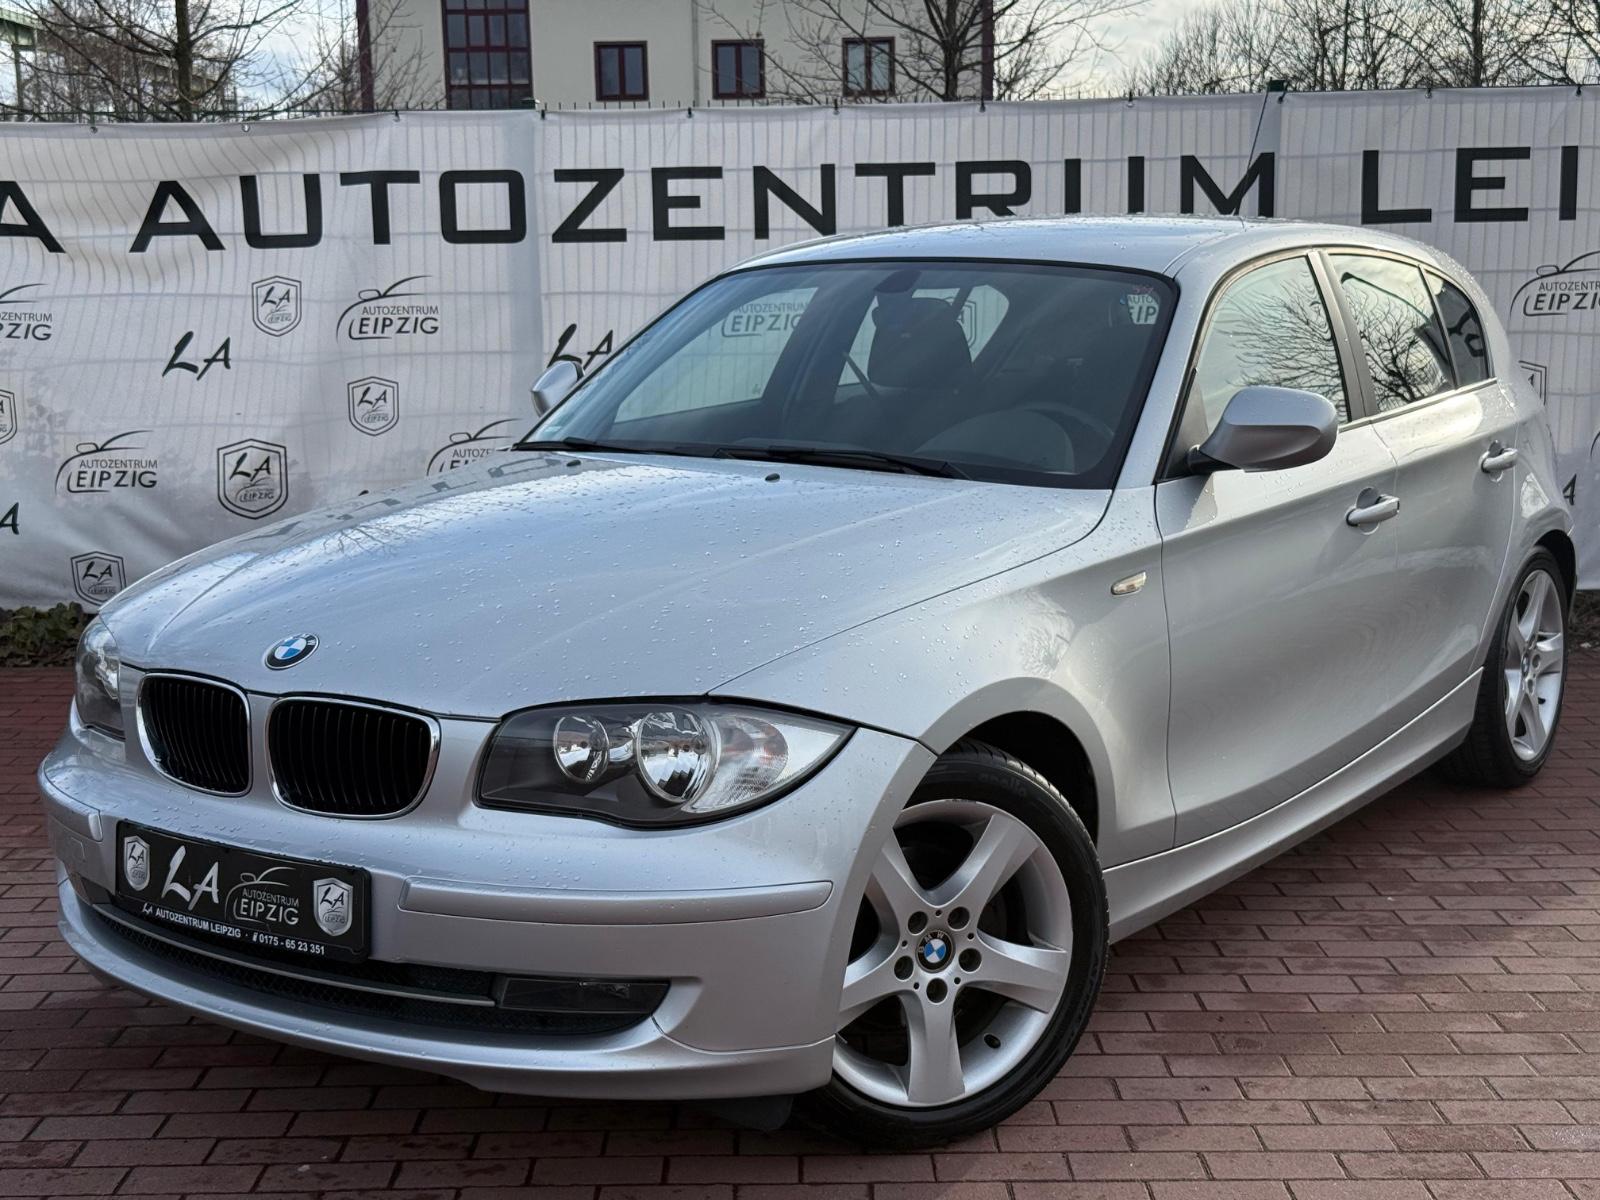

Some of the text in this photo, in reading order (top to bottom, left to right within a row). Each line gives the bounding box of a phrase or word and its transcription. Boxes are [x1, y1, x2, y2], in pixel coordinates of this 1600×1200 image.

[1361, 145, 1579, 224] LEI
[261, 286, 291, 308] LA
[1523, 292, 1600, 317] LEIPZI
[0, 312, 53, 322] ZENTRUM
[362, 305, 439, 315] AUTOZENTRUM
[162, 331, 231, 381] LA
[547, 323, 613, 371] LA
[357, 386, 387, 408] LA
[80, 459, 157, 469] AUTOZENTRUM
[229, 452, 271, 482] LA
[82, 561, 112, 581] LA
[161, 845, 219, 911] LA
[242, 888, 299, 907] AUTOZENTRUM
[320, 886, 344, 908] LA
[156, 908, 209, 931] AUTOZENTRUM
[210, 922, 241, 938] LEIPZIG
[259, 933, 279, 946] 0175
[285, 939, 296, 949] 65
[297, 941, 308, 952] 23
[310, 944, 325, 955] 351
